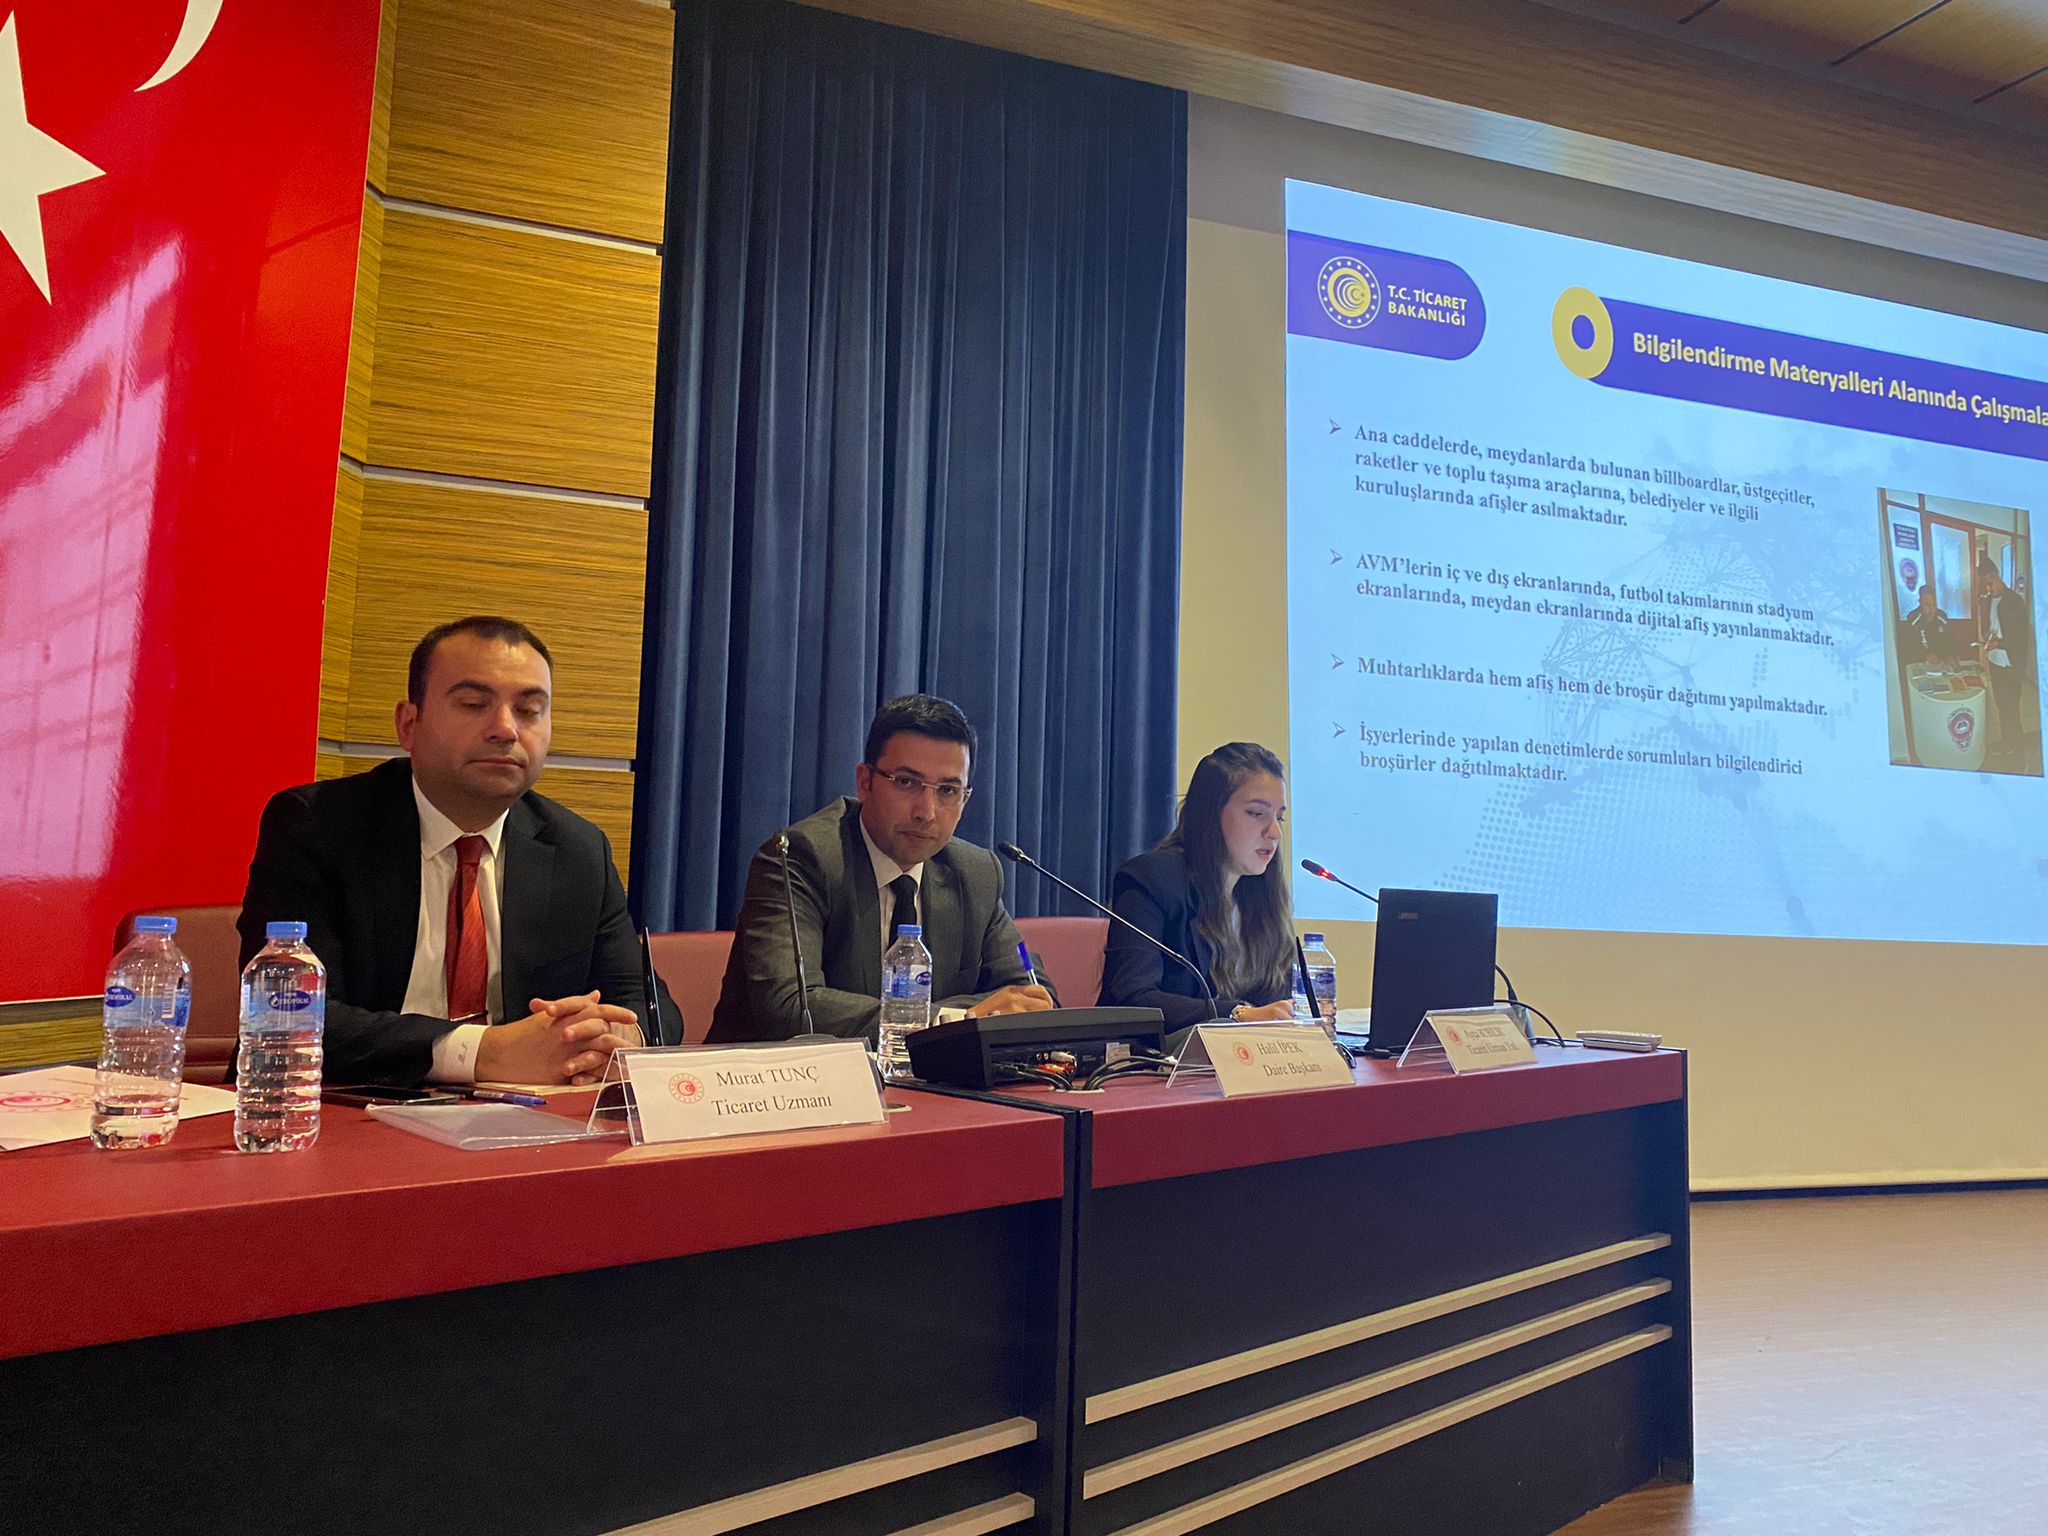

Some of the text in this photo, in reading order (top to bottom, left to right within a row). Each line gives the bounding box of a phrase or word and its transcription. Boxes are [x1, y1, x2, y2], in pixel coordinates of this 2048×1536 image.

[1387, 285, 1467, 311] T.C. TİCARET
[1388, 301, 1466, 327] BAKANLIĞI
[1633, 331, 1766, 376] Bilgilendirme
[1770, 357, 1884, 397] Materyalleri
[1888, 379, 1967, 412] Alanında
[1355, 425, 1815, 509] Ana caddelerde, meydanlarda bulunan billboardlar, üstgeçitler,
[1355, 452, 1759, 522] raketler ve toplu taşıma araçlarına, belediyeler ve ilgili
[1355, 475, 1628, 526] kuruluşlarında afişler asılmaktadır.
[1356, 579, 1834, 646] ekranlarında, meydan ekranlarında dijital afiş yayınlanmaktadır.
[1447, 563, 1460, 584] iç
[1464, 569, 1482, 582] ve
[1487, 569, 1509, 588] dış
[1514, 572, 1616, 600] ekranlarında,
[1620, 584, 1664, 604] futbol
[1667, 591, 1754, 614] takımlarının
[1757, 602, 1814, 622] stadyum
[1357, 657, 1828, 716] Muhtarlıklarda hem afiş hem de broşür dağıtımı yapılmaktadır.
[1359, 721, 1803, 775] İşyerlerinde yapılan denetimlerde sorumluları bilgilendirici
[1360, 751, 1568, 781] broşürler dağıtılmaktadır.
[1256, 1040, 1280, 1055] Halil
[1263, 1061, 1323, 1077] Daire Başkanı
[716, 1066, 820, 1087] Murat TUNÇ
[711, 1095, 833, 1116] Ticaret Uzmanı
